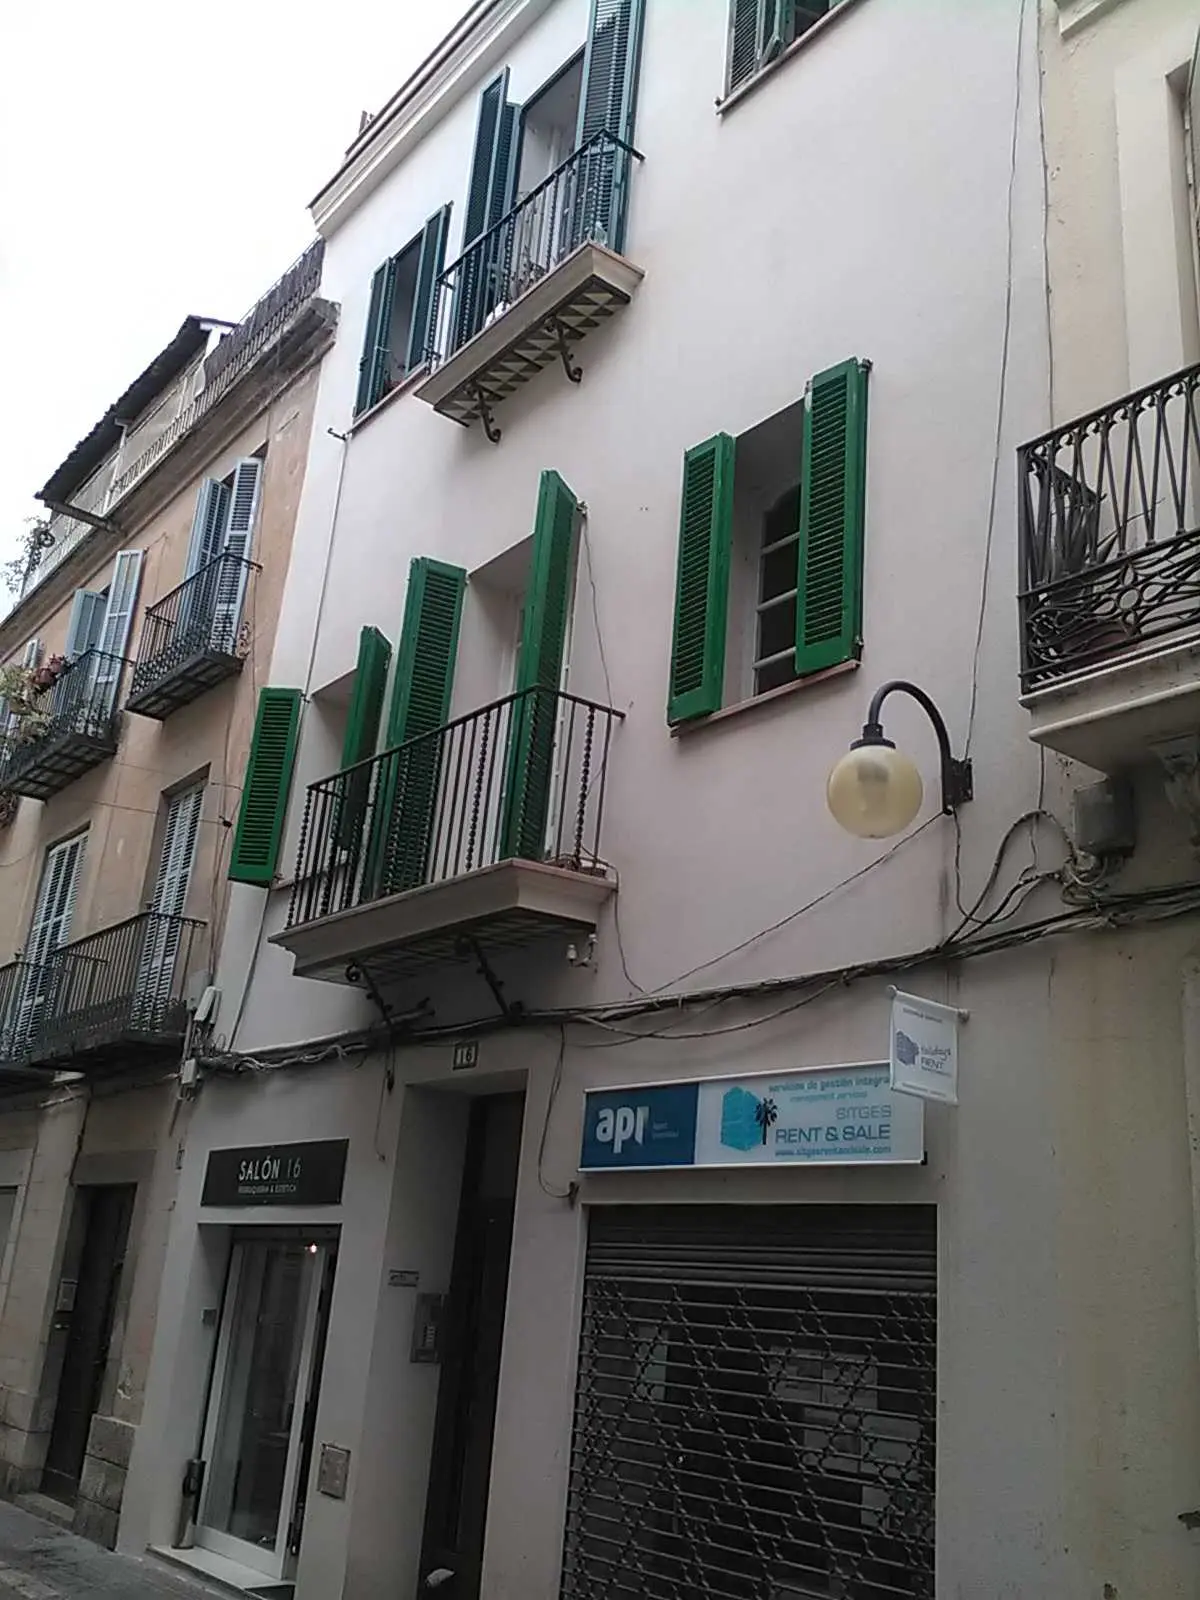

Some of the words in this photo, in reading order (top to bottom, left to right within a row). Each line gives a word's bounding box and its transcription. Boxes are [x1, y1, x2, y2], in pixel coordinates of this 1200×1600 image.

[835, 1104, 892, 1121] SITGES
[775, 1127, 823, 1144] RENT
[825, 1126, 839, 1142] &
[842, 1123, 891, 1142] SALE
[238, 1154, 281, 1181] SALÓN
[286, 1157, 302, 1179] 16
